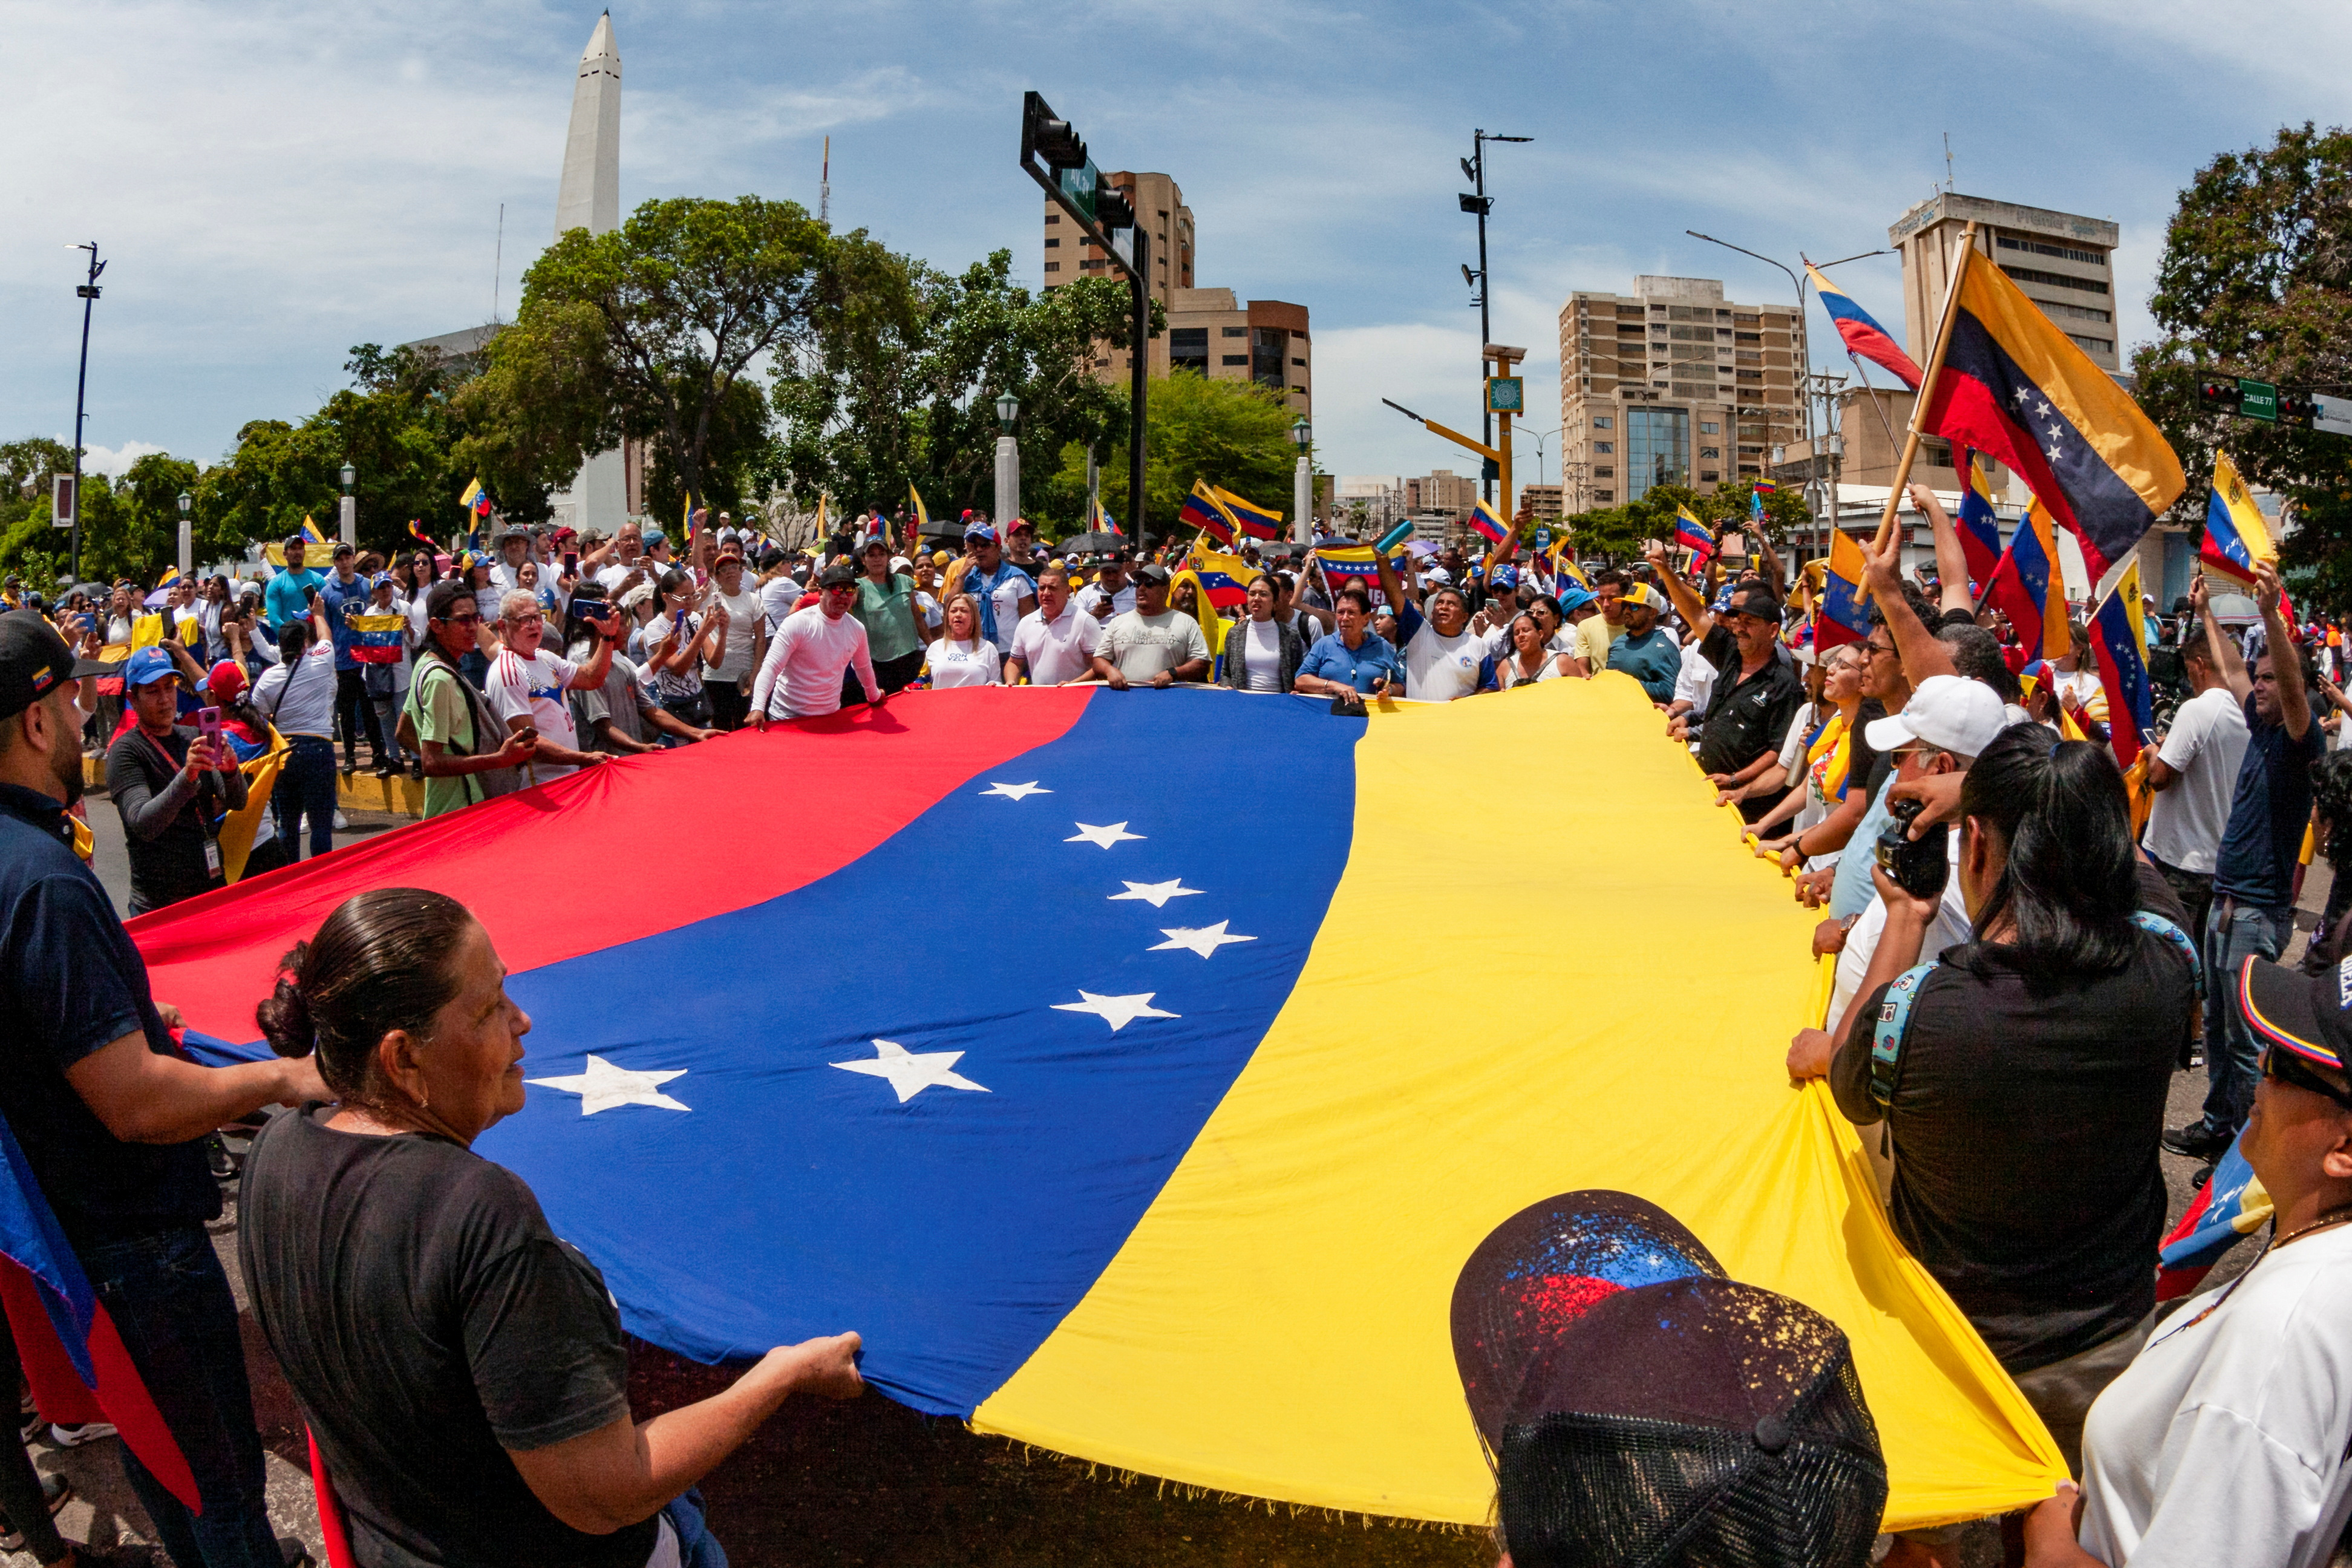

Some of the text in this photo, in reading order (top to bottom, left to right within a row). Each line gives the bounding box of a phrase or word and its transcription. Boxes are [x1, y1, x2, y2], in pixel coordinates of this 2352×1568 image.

[2017, 207, 2068, 230] Premier
[2244, 393, 2273, 406] CALLE 77
